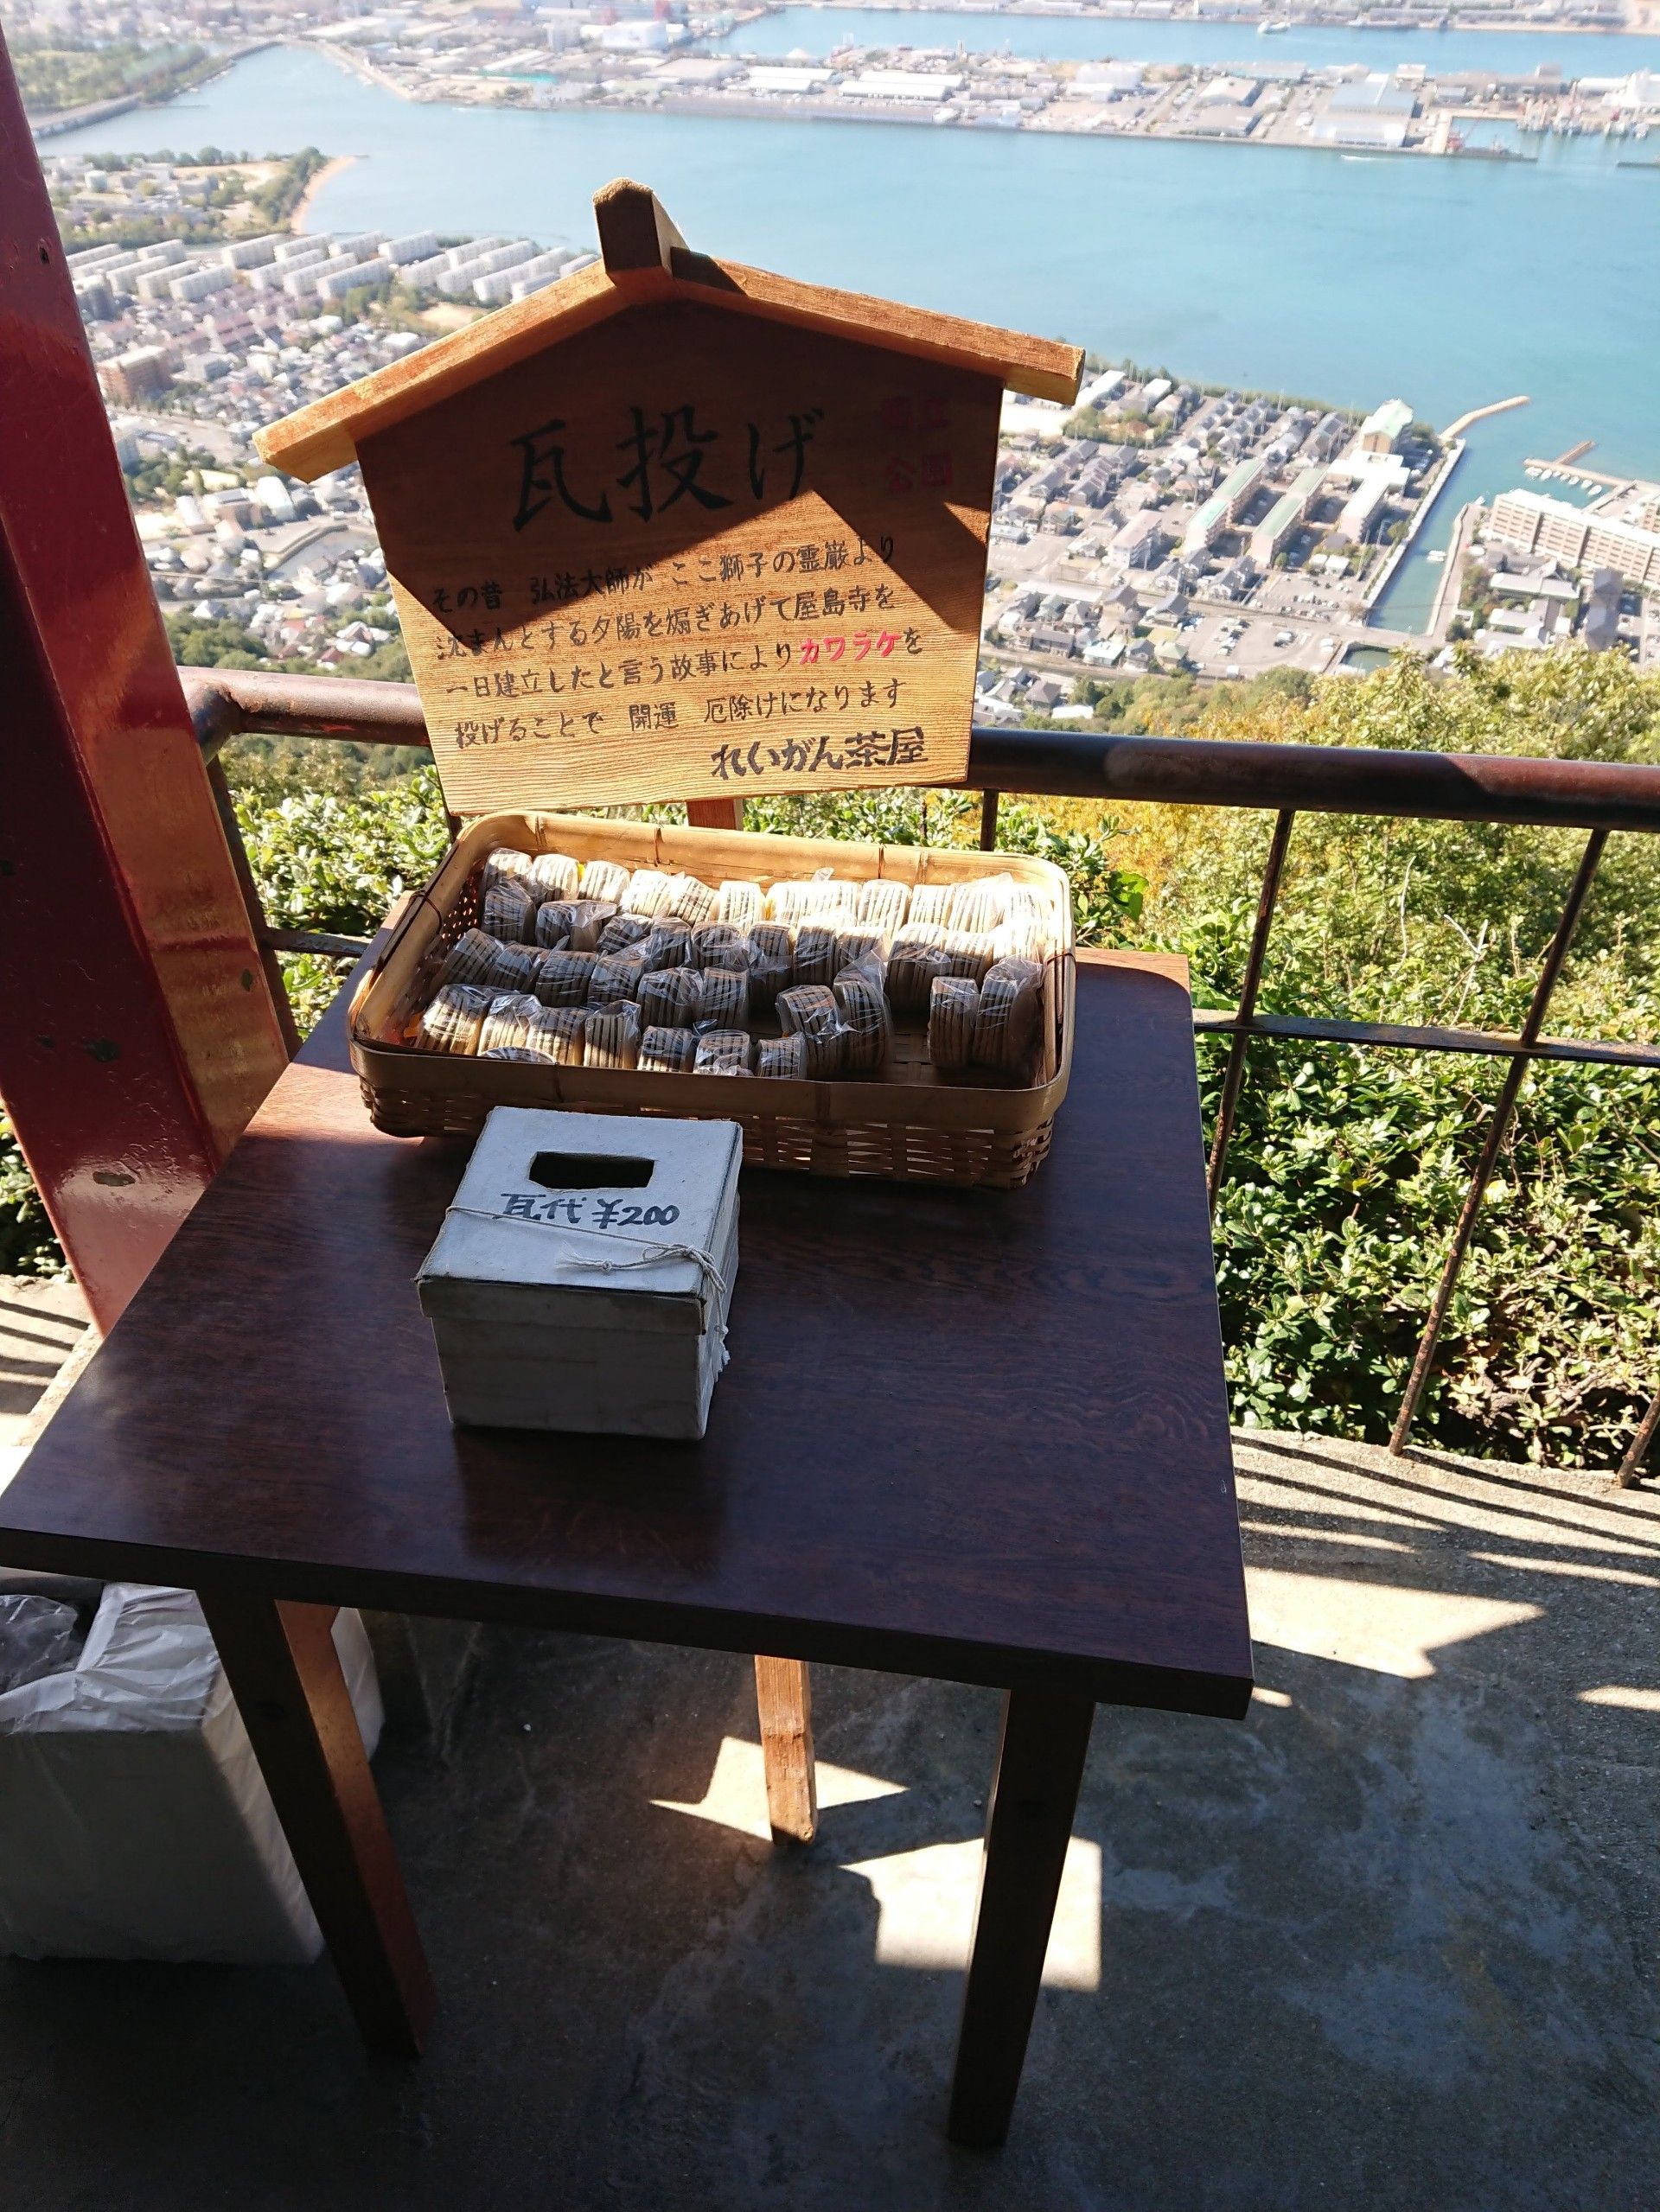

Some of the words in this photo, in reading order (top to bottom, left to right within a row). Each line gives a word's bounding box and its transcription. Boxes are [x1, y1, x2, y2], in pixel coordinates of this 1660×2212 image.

[510, 403, 826, 532] 瓦投げ
[433, 579, 504, 613] その昔
[529, 562, 654, 605] 弘法大師が
[455, 711, 604, 749] 投げることで
[629, 701, 679, 732] 開運
[703, 678, 907, 724] 厄除けになります
[709, 725, 929, 781] れいがん茶屋
[493, 1193, 588, 1224] 瓦代
[591, 1197, 680, 1229] ¥200
